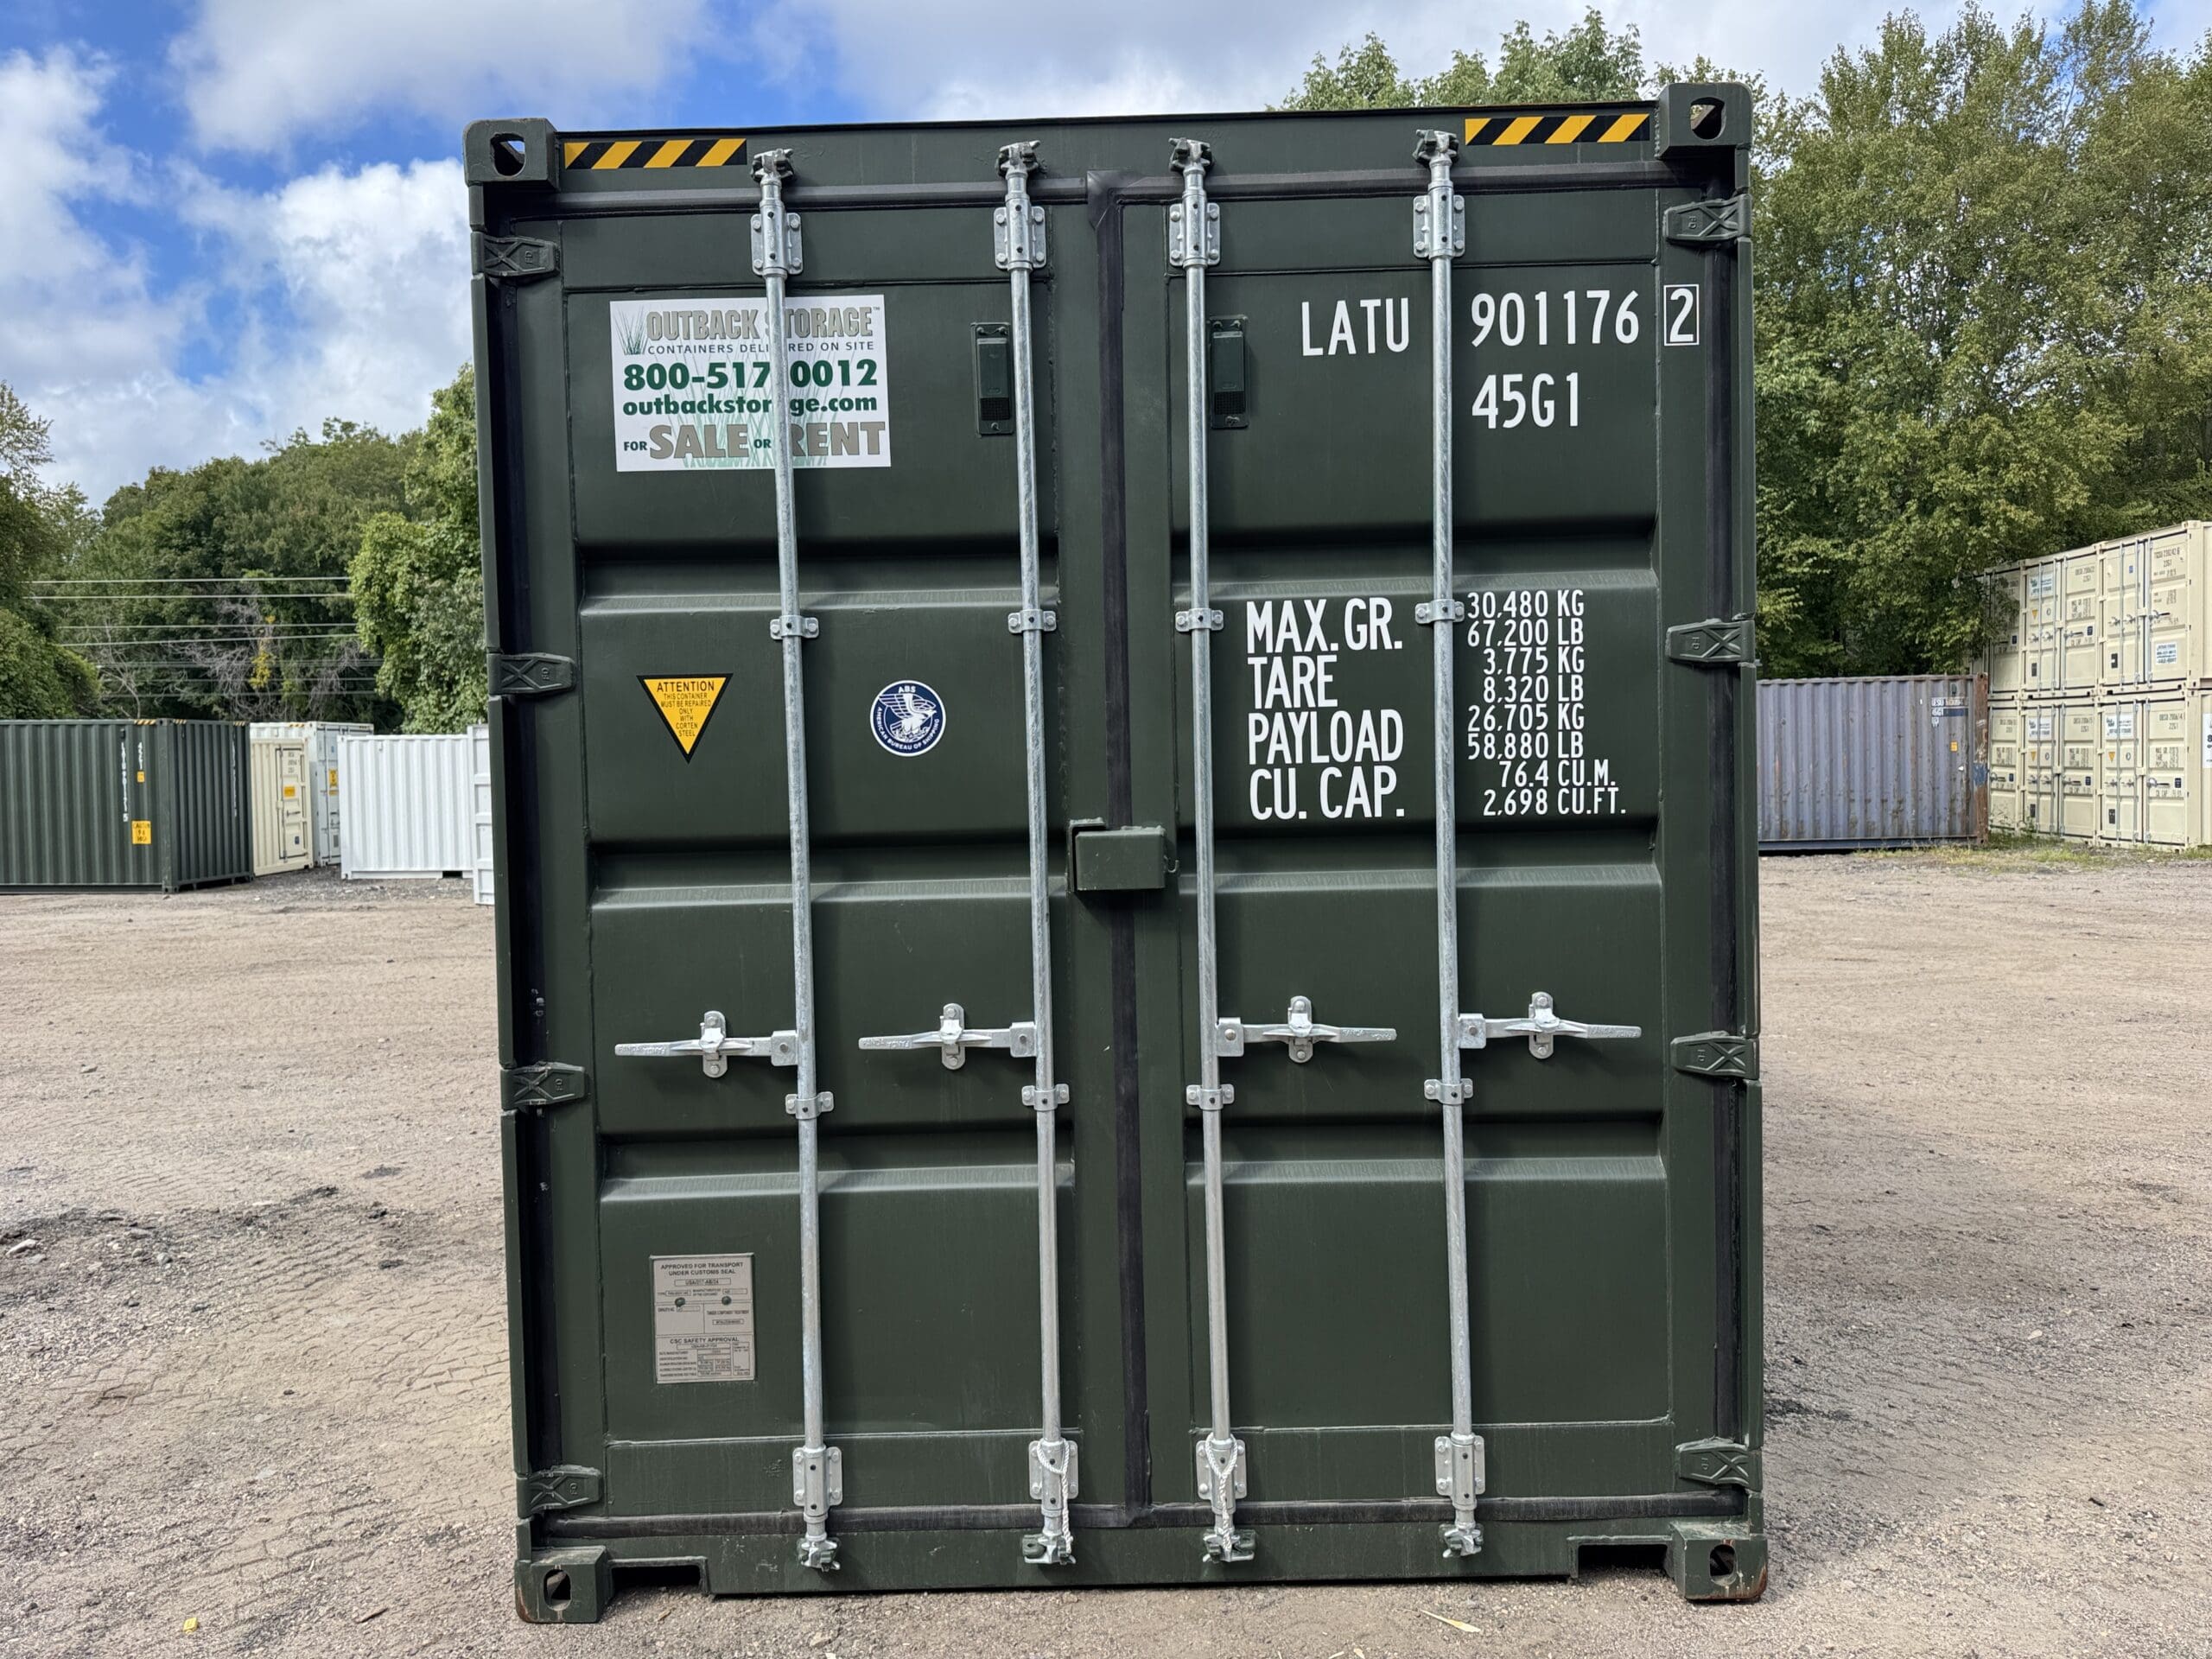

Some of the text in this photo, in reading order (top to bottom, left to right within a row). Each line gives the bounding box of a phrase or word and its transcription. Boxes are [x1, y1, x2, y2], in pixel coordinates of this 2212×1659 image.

[647, 309, 760, 341] OUTBACK
[765, 307, 874, 339] TORAGE
[1301, 288, 1695, 356] LATU 901176 2
[648, 340, 874, 355] CONTAINERS DELIRED ON SITE
[622, 393, 878, 417] outbackstorge.com
[1471, 372, 1579, 429] 45G1
[623, 441, 648, 452] FOR
[649, 423, 749, 460] SALE
[753, 438, 772, 449] OR
[1467, 589, 1585, 620] 30,480 KG
[1467, 618, 1584, 648] 67,200 LB
[1483, 646, 1585, 676] 3,775 KG
[657, 681, 715, 692] ATTENTION
[1248, 654, 1338, 709] TARE
[1483, 675, 1584, 704] 8,320 LB
[1467, 702, 1585, 733] 26,705 KG
[1248, 709, 1404, 766] PAYLOAD
[1467, 731, 1584, 760] 58,880 LB
[1498, 760, 1548, 788] 76.4
[1249, 766, 1406, 821] CU. CAP.
[1483, 789, 1548, 817] 2,698
